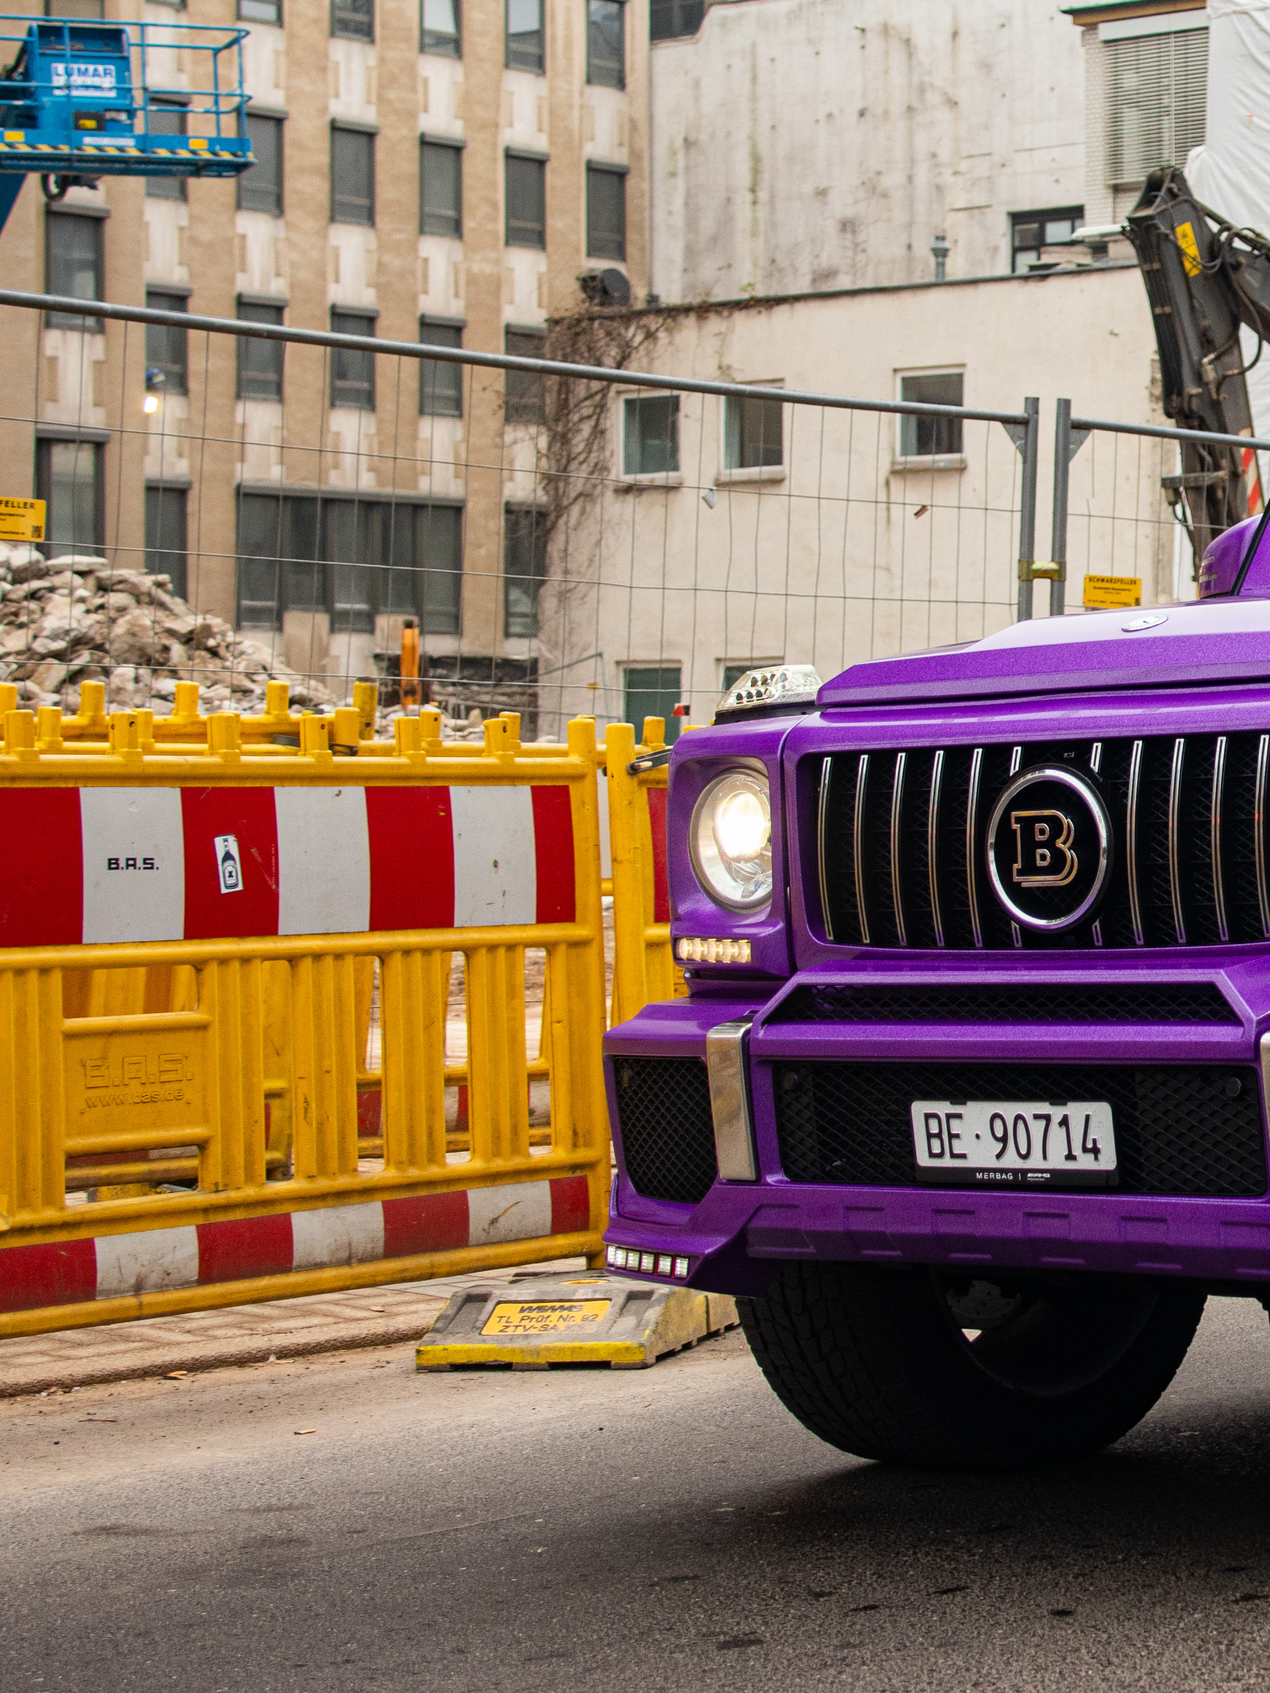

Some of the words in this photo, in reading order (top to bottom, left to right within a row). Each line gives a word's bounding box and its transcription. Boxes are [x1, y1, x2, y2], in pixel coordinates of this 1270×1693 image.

[54, 66, 113, 77] LUMAR
[1011, 810, 1078, 887] B
[107, 857, 159, 871] B.A.S.
[85, 1053, 193, 1090] B.A.S.
[976, 1172, 1014, 1180] MERBAG
[496, 1315, 513, 1324] TL
[519, 1313, 553, 1324] Prüf.
[556, 1313, 576, 1322] Nr.
